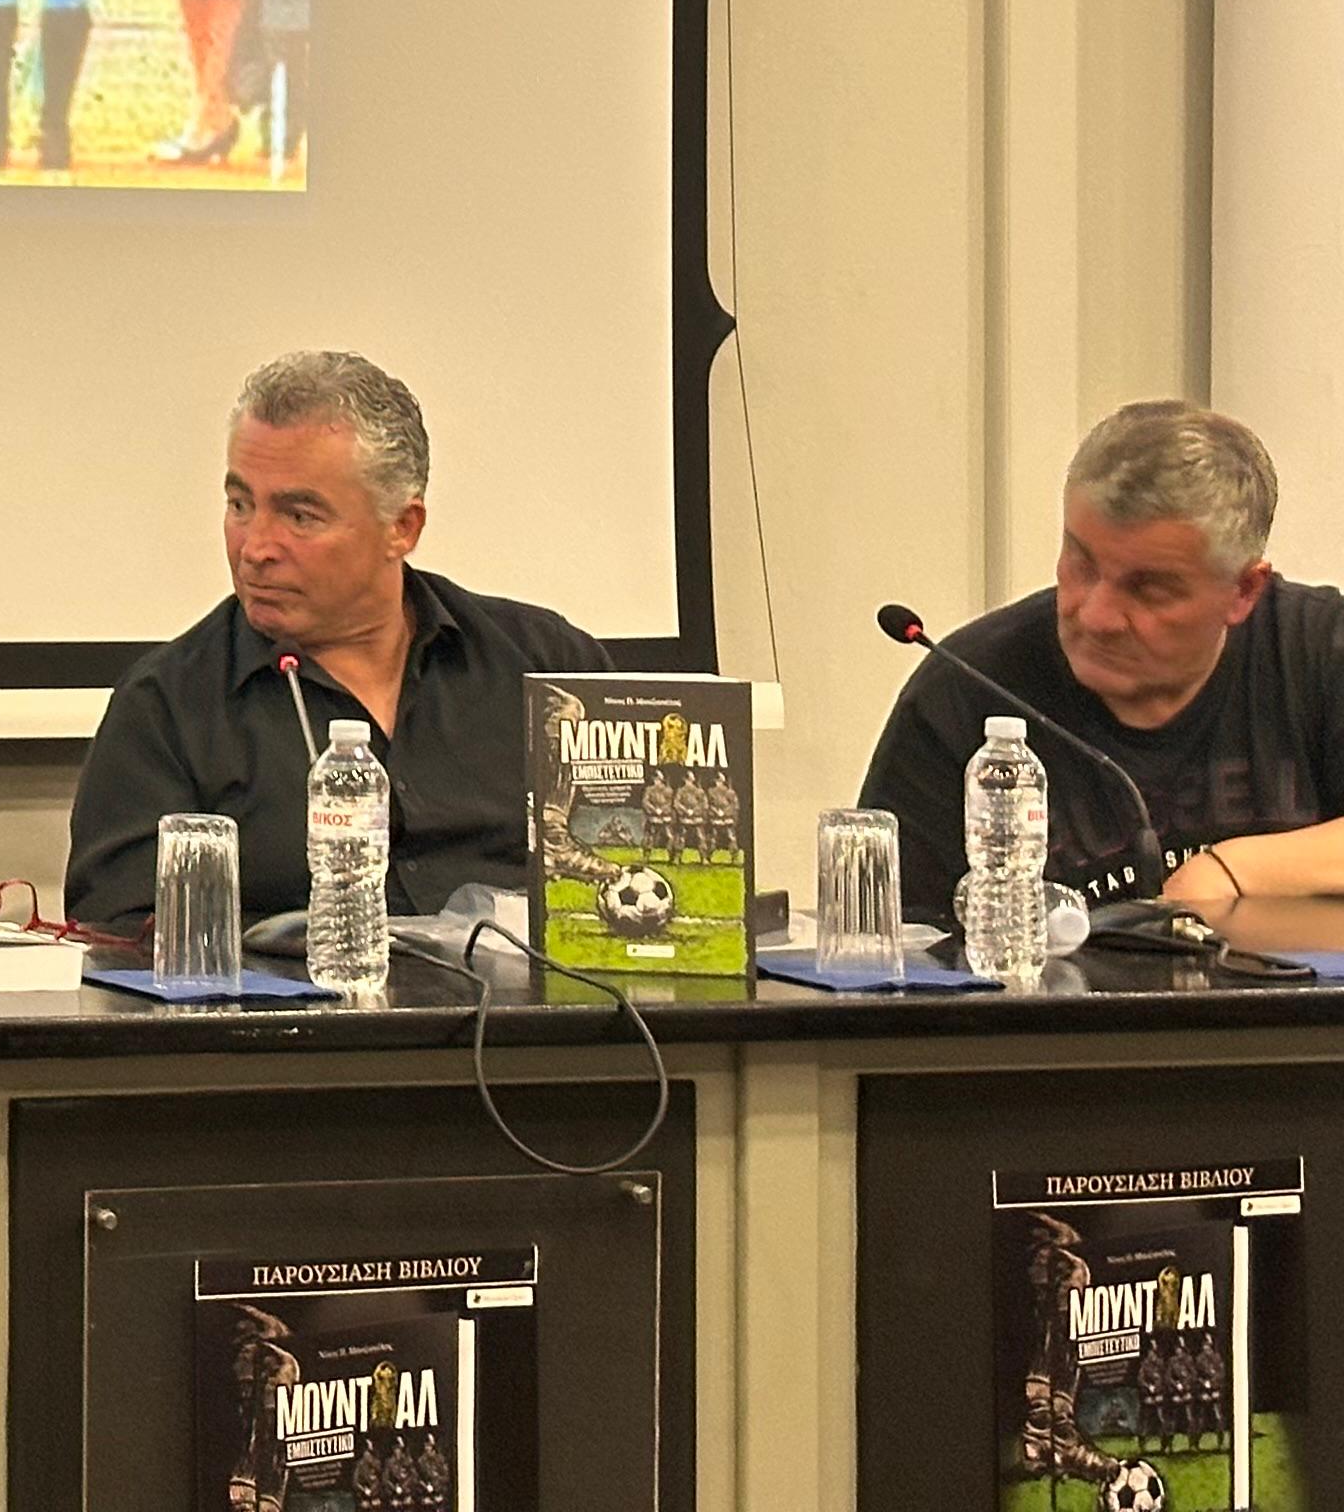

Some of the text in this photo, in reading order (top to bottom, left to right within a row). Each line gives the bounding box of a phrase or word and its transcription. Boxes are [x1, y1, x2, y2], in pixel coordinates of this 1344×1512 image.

[1046, 1167, 1255, 1195] ΠΑΡΟΥΣΙΑΣΗ ΒΙΒΛΙΟΥ
[252, 1256, 483, 1286] ΠΑΡΟΥΣΙΑΣΗ ΒΙΒΛΙΟΥ
